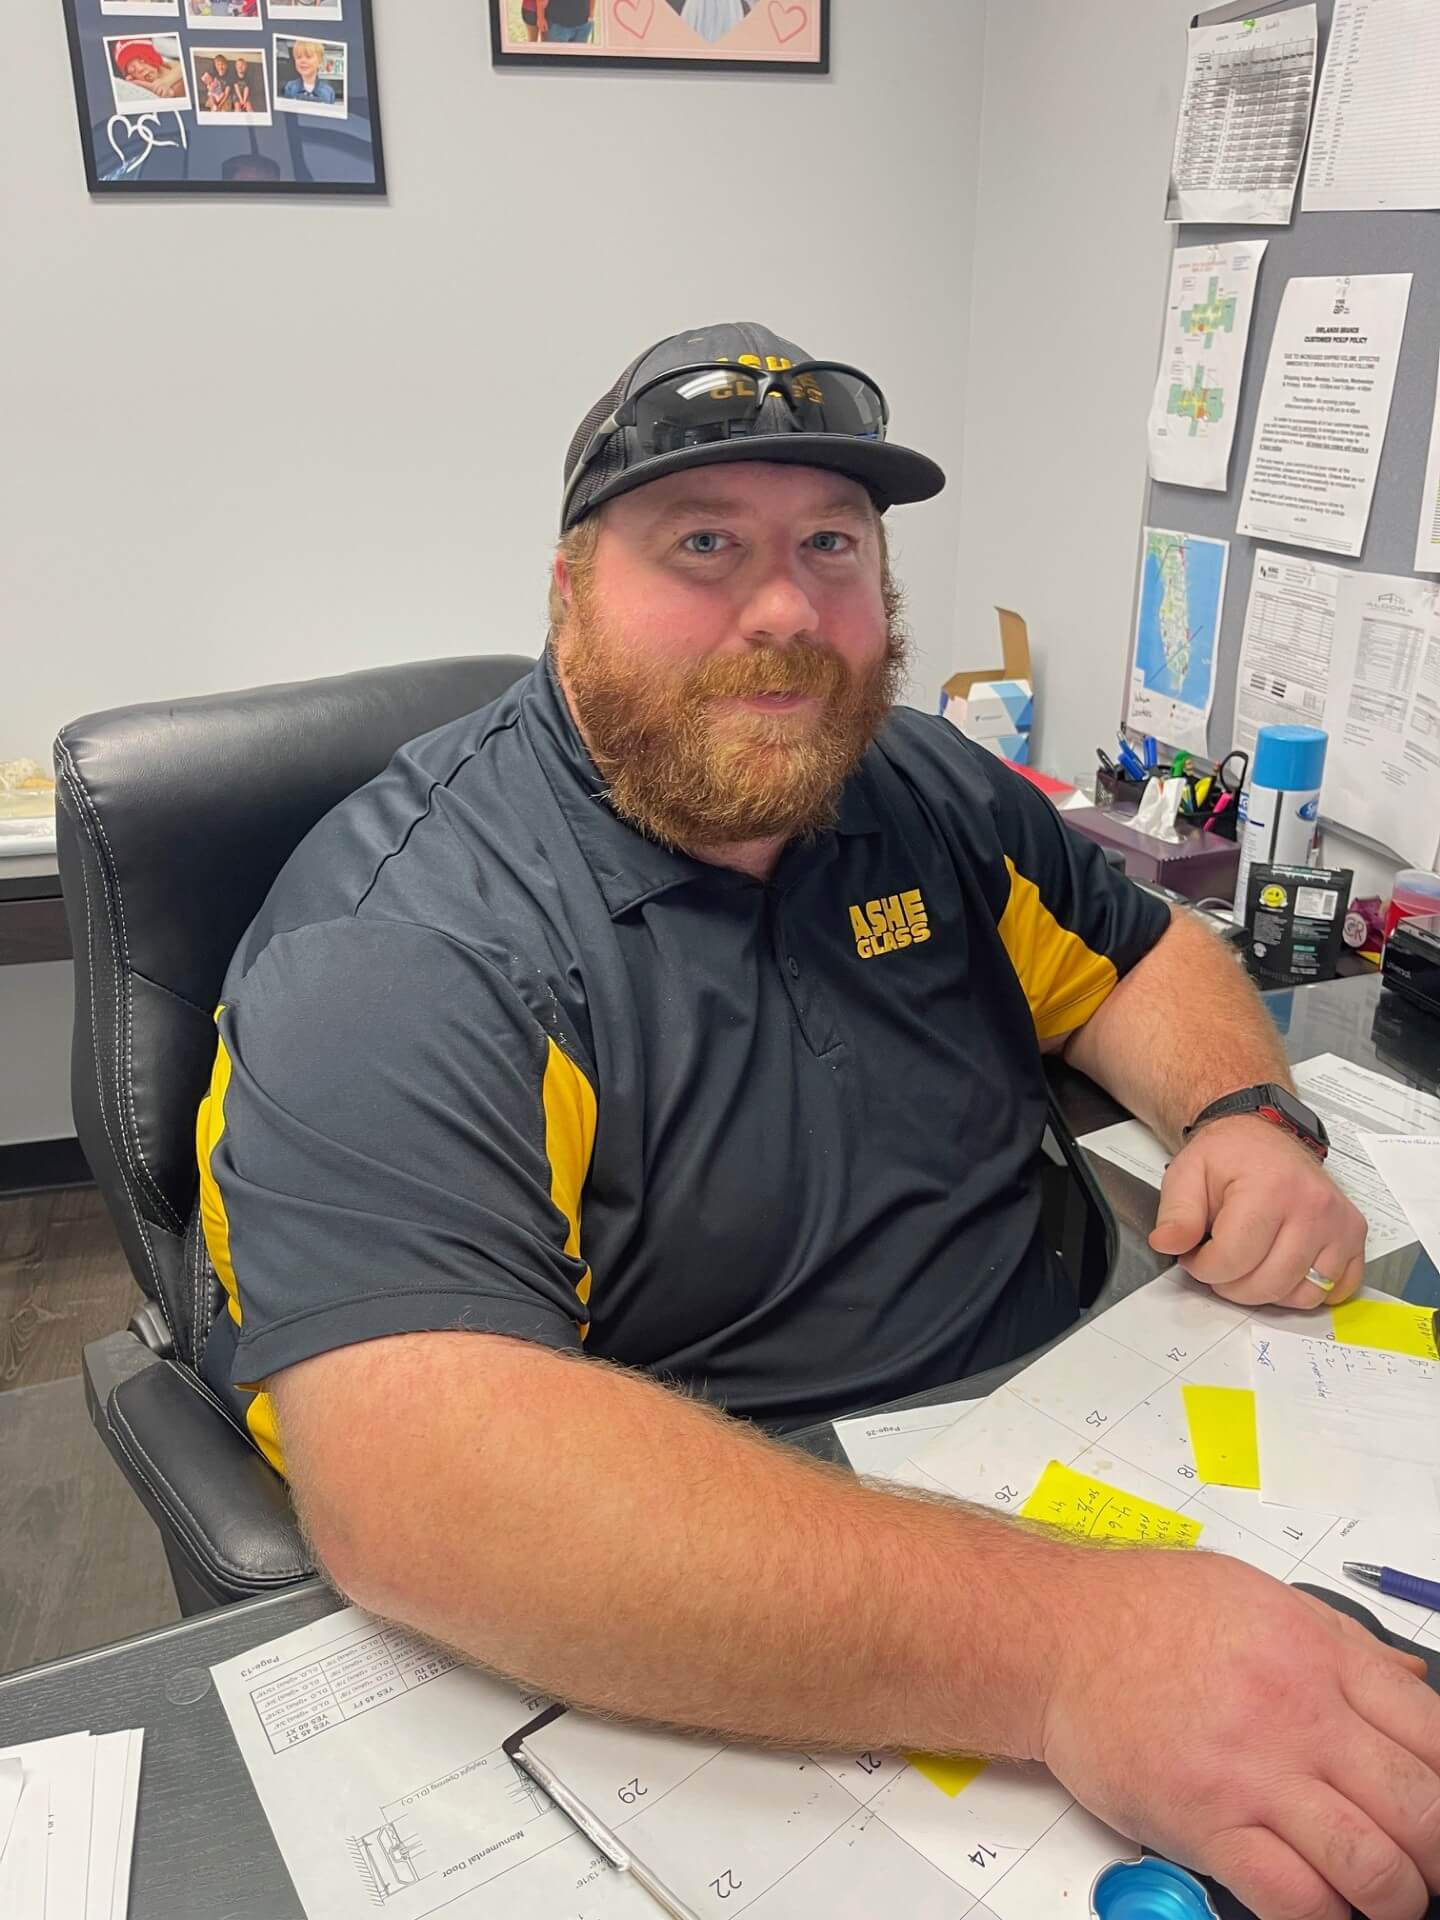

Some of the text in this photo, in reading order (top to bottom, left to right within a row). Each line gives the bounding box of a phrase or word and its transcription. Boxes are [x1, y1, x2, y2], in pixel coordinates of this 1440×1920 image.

[709, 379, 825, 405] GLSS
[848, 888, 929, 942] ASHE
[857, 922, 931, 959] GLASS
[1166, 1347, 1187, 1362] 24
[1086, 1409, 1108, 1428] 25
[1176, 1464, 1197, 1479] 18
[994, 1485, 1019, 1503] 26
[1282, 1525, 1304, 1541] 11
[239, 1653, 280, 1678] Page-13
[413, 1666, 426, 1676] TU
[416, 1671, 429, 1682] TU
[364, 1693, 376, 1703] 45
[375, 1684, 394, 1698] YES
[283, 1712, 328, 1737] YES 60 XT
[286, 1718, 330, 1744] YES 45 XT
[856, 1752, 882, 1775] 21
[617, 1777, 649, 1806] 29
[439, 1828, 525, 1880] Monumental Door
[967, 1843, 998, 1870] 14
[709, 1869, 743, 1899] 22
